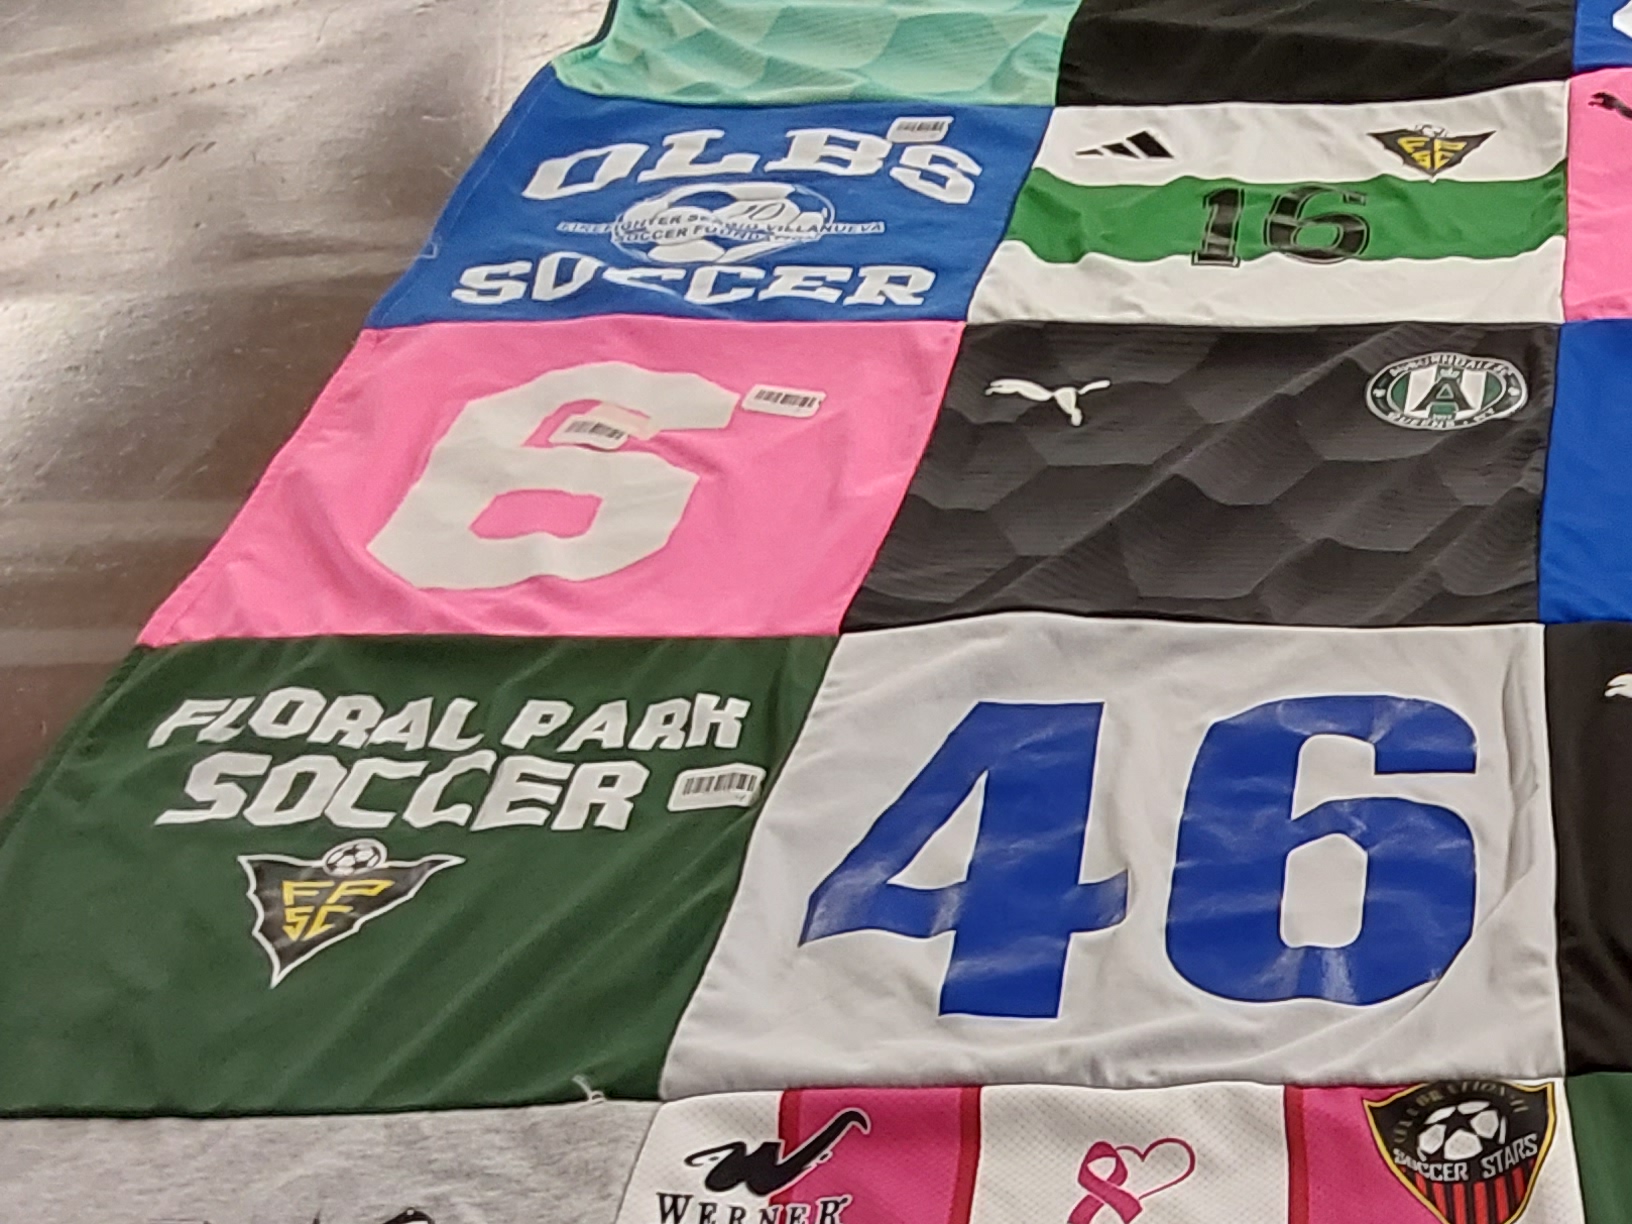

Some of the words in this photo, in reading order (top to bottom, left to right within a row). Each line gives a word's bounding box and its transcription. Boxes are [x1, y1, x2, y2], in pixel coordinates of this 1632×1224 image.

[1192, 184, 1371, 268] 16
[451, 251, 938, 306] SOCCER
[366, 360, 742, 590] 6
[148, 686, 488, 752] FLORAL
[502, 693, 751, 753] PARK
[153, 750, 651, 832] SOCCER
[281, 879, 396, 906] FP
[799, 693, 1478, 1020] 46
[1480, 1132, 1539, 1180] STARS
